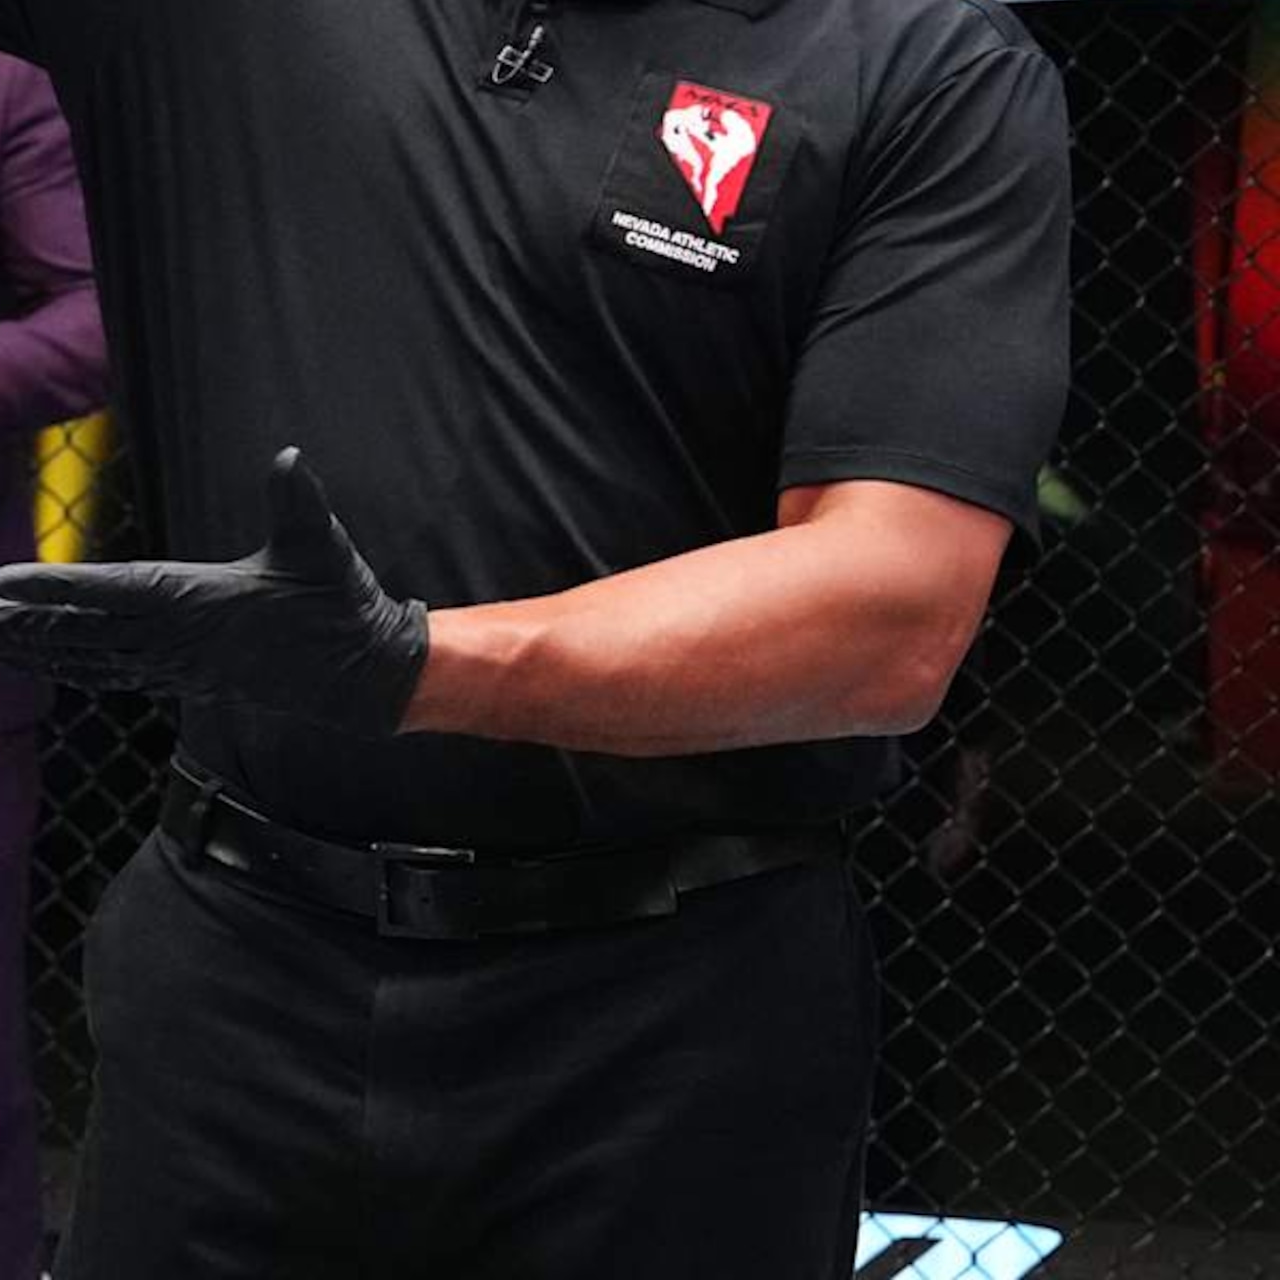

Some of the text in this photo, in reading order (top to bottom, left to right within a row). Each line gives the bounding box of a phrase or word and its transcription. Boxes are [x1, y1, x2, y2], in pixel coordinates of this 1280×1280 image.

[612, 211, 742, 265] NEVADA ATHLETIC
[624, 231, 719, 272] COMMISSION
